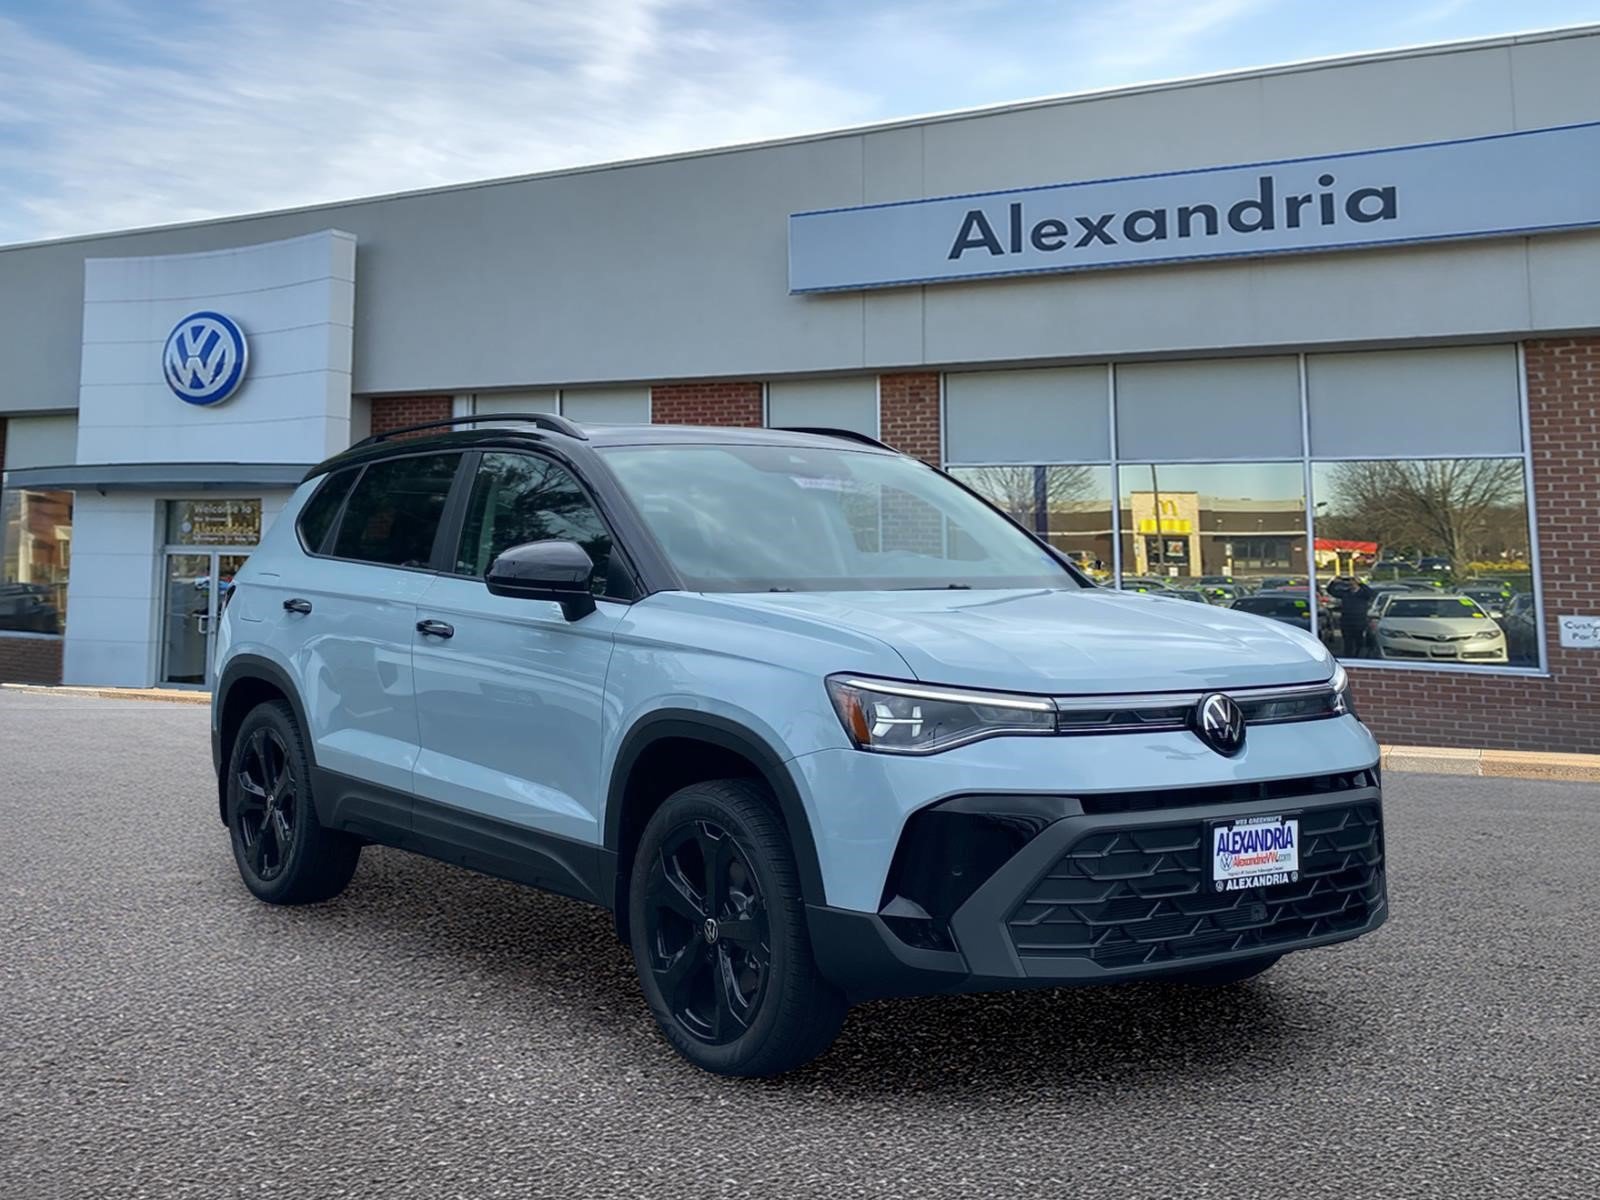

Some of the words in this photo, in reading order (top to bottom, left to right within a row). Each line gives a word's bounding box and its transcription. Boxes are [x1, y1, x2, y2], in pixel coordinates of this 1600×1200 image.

[948, 174, 1398, 260] Alexandria
[194, 504, 239, 514] Welcome
[1216, 825, 1294, 857] ALEXANDRIA
[1226, 873, 1289, 891] ALEXANDRIA
